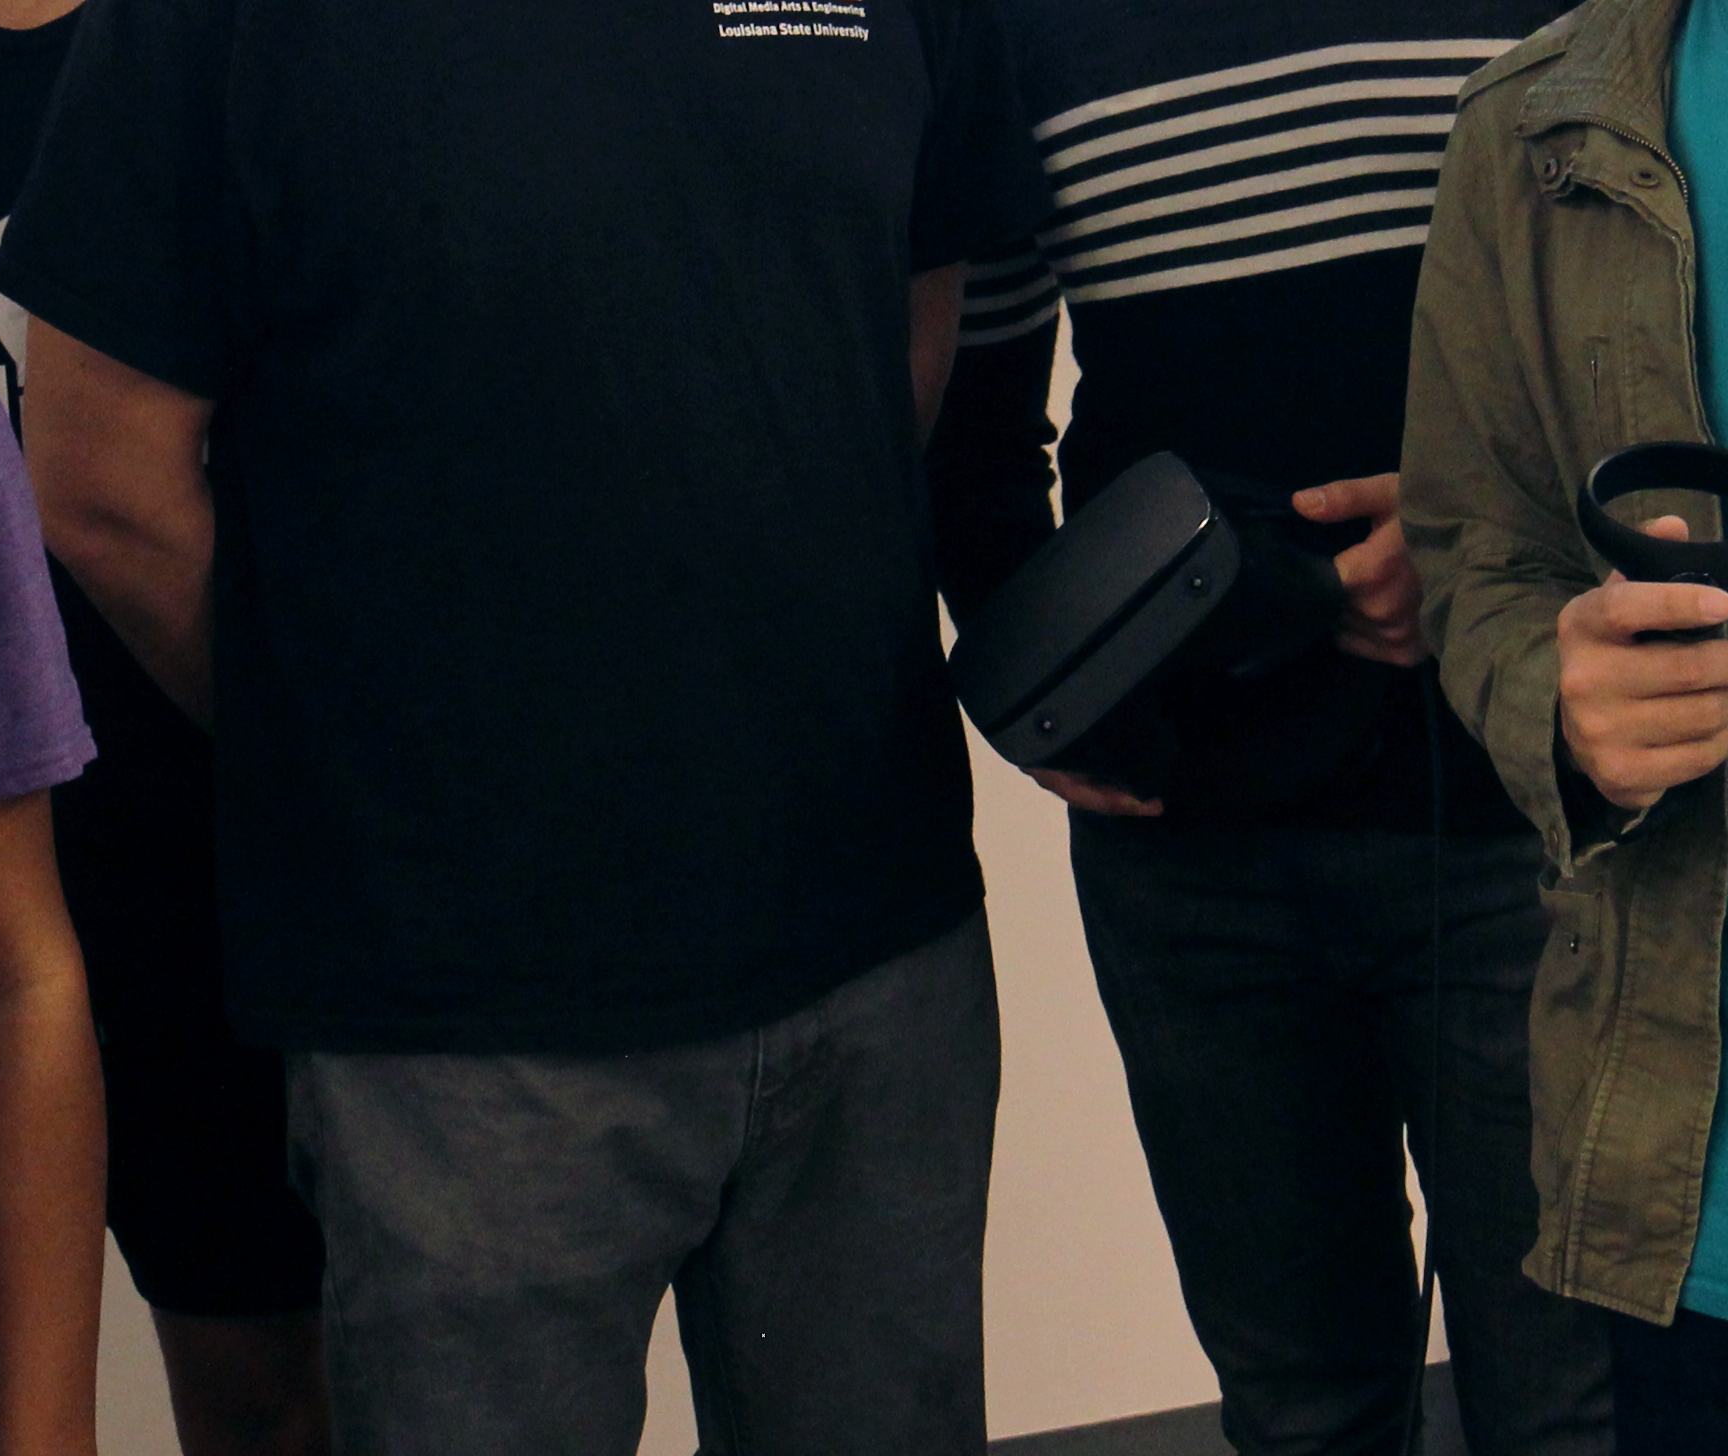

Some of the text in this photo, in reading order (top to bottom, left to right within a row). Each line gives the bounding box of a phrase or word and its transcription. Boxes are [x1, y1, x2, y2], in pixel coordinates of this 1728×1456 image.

[712, 0, 866, 18] Digital Media Arts & Engineering
[718, 22, 869, 41] Louisiana State University
